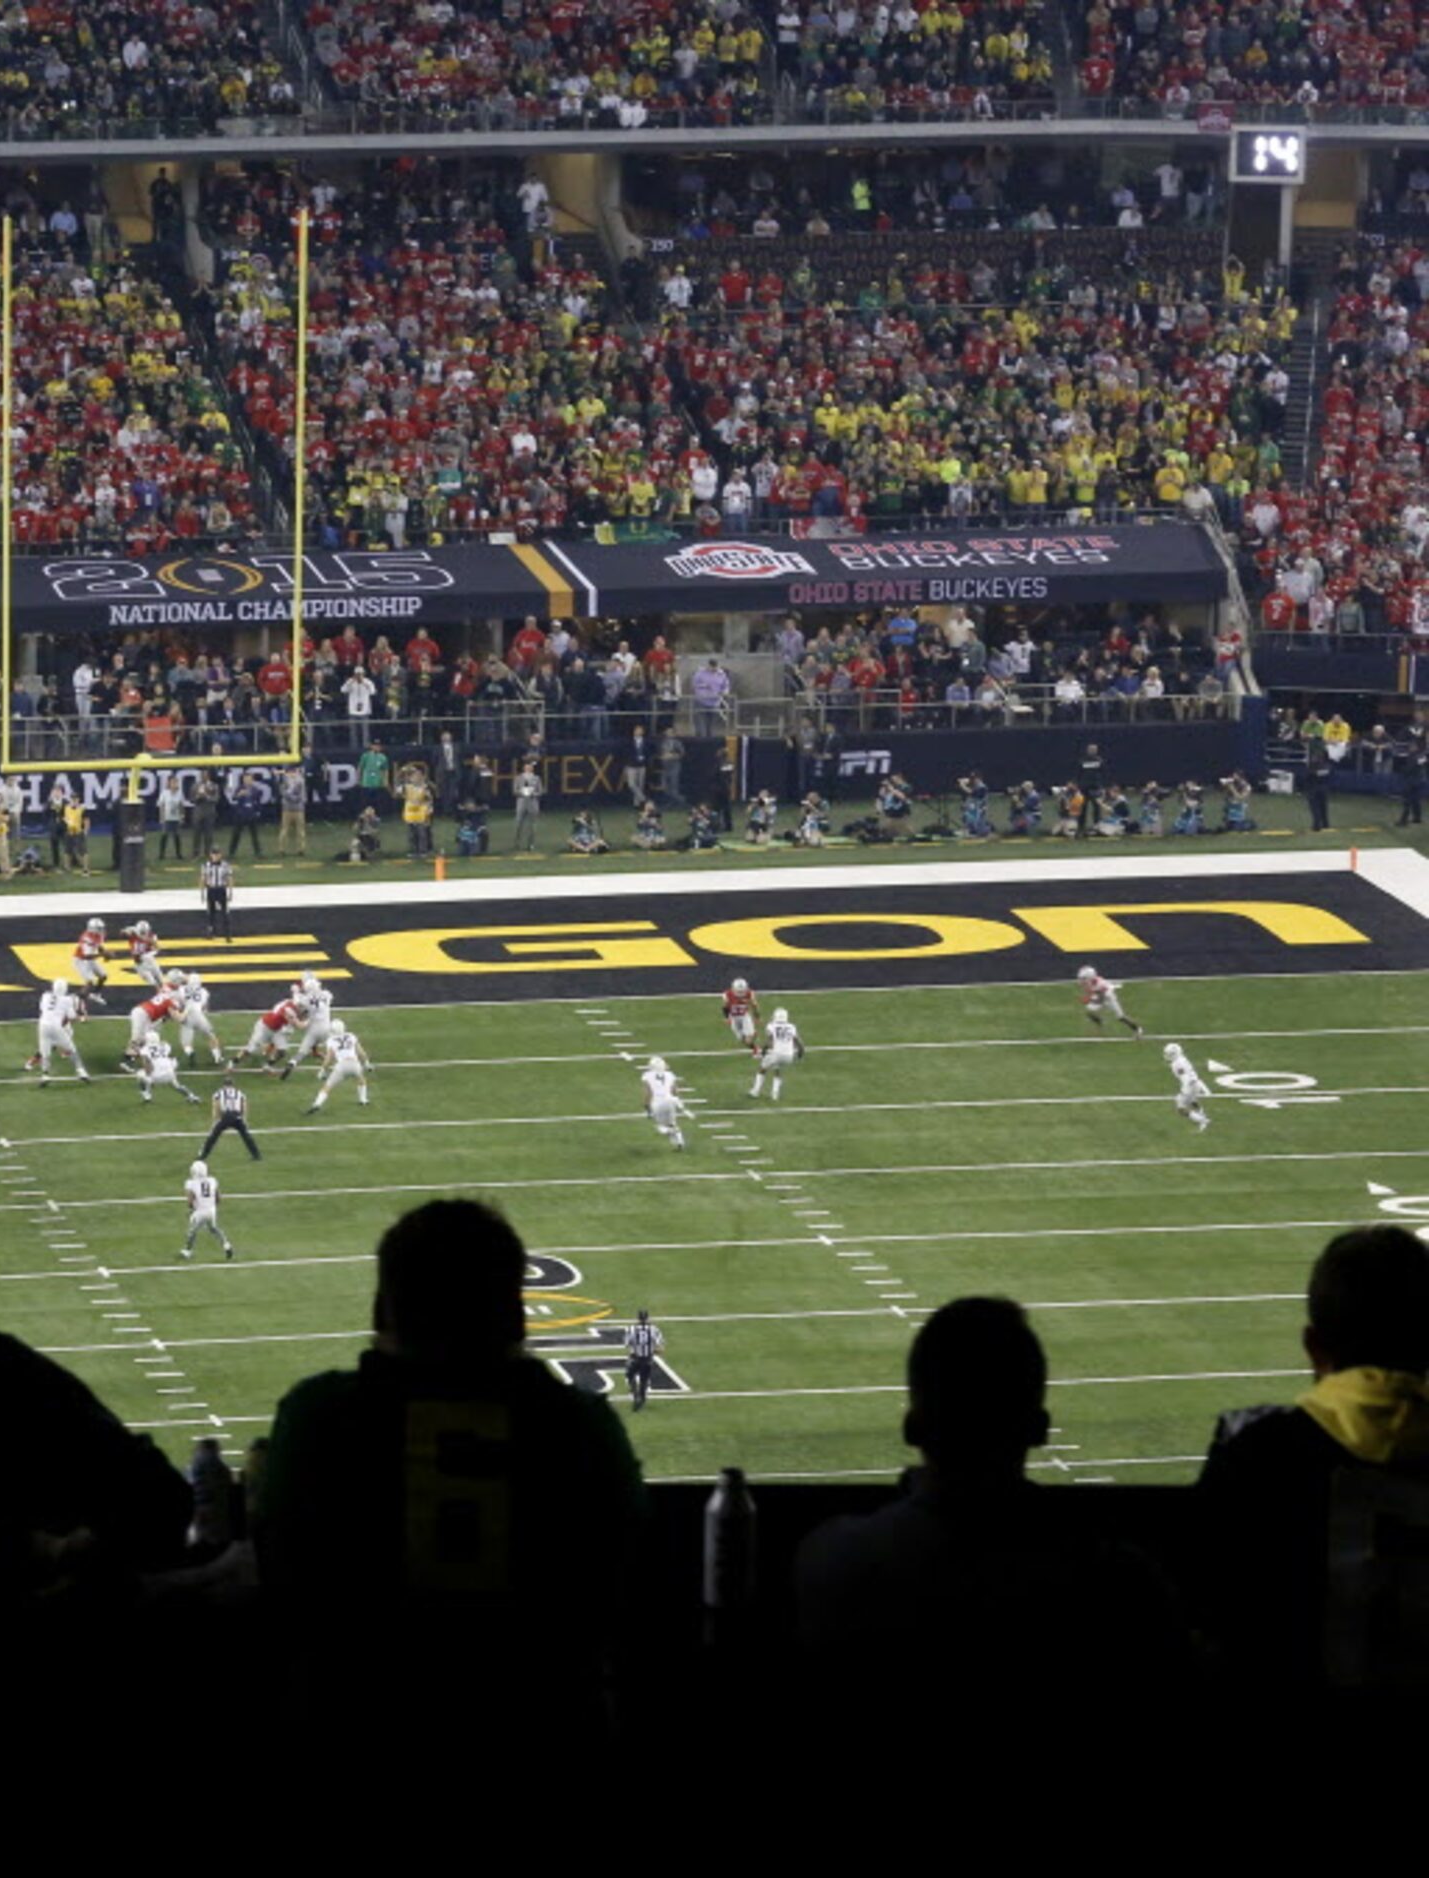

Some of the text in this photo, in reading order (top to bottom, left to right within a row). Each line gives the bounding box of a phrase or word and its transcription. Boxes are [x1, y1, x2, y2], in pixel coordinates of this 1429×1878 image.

[1253, 136, 1299, 172] 14
[827, 534, 1121, 558] OHIO STATE
[840, 548, 1111, 571] BUCKEYES
[789, 577, 1048, 604] OHIO STATE BUCKEYES
[108, 596, 422, 625] NATIONAL CHAMPIONSHIP
[405, 1400, 511, 1589] 6
